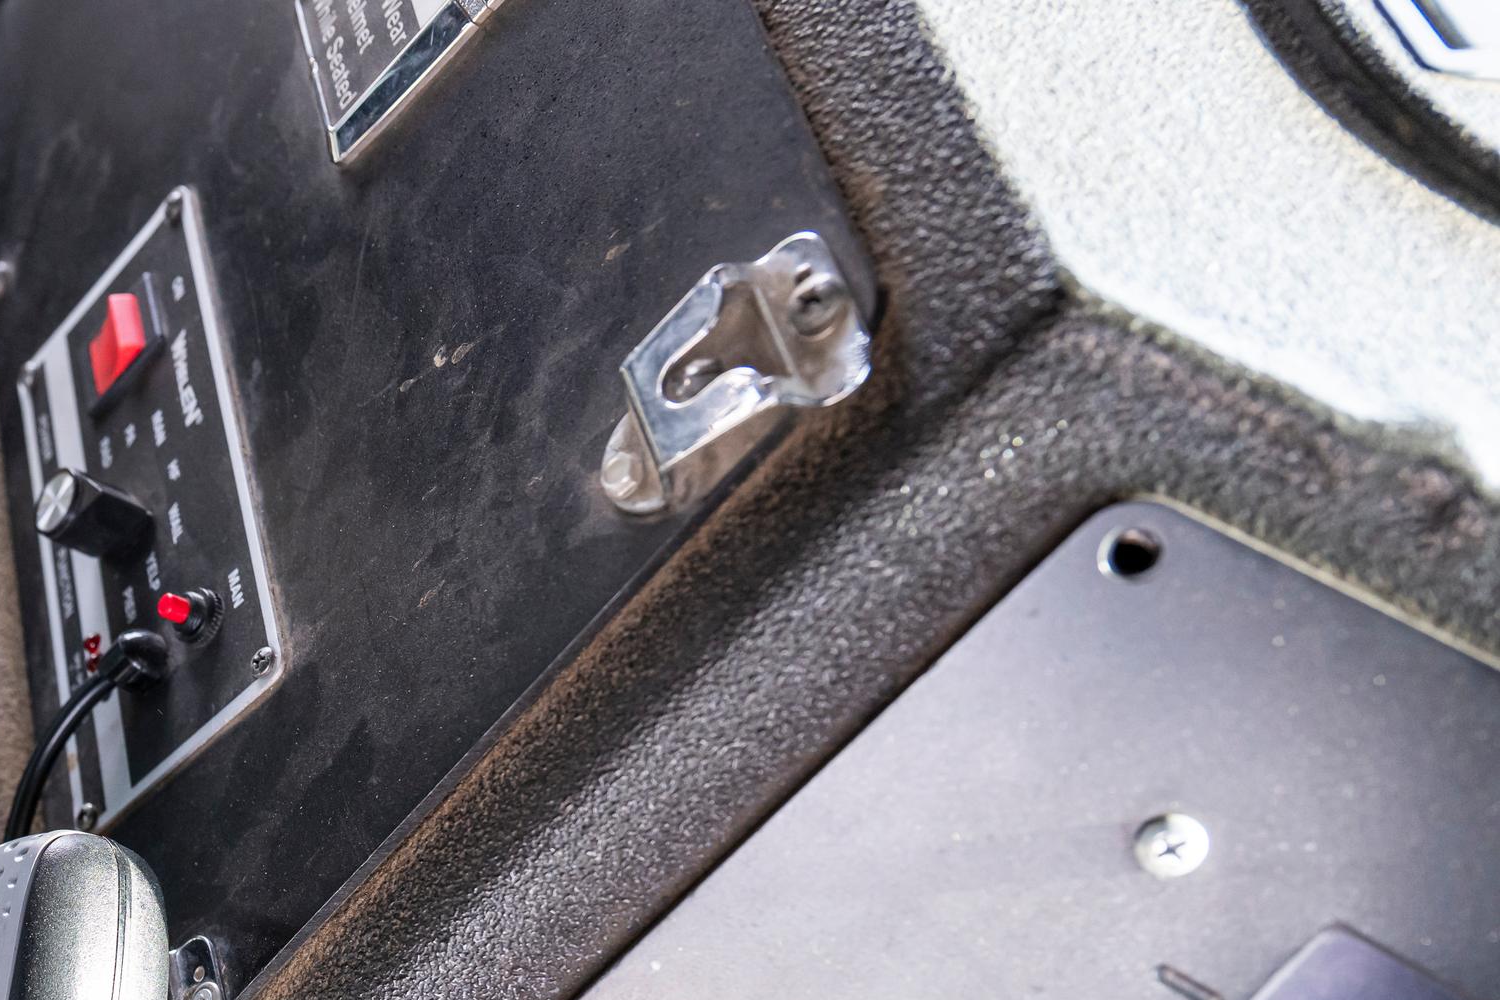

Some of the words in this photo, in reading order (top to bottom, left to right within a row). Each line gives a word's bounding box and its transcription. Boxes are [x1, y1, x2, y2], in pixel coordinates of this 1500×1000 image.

[346, 0, 375, 55] elmet
[381, 0, 407, 46] Wear
[326, 36, 357, 110] Seated
[168, 502, 183, 545] WAIL
[227, 567, 244, 609] MAN
